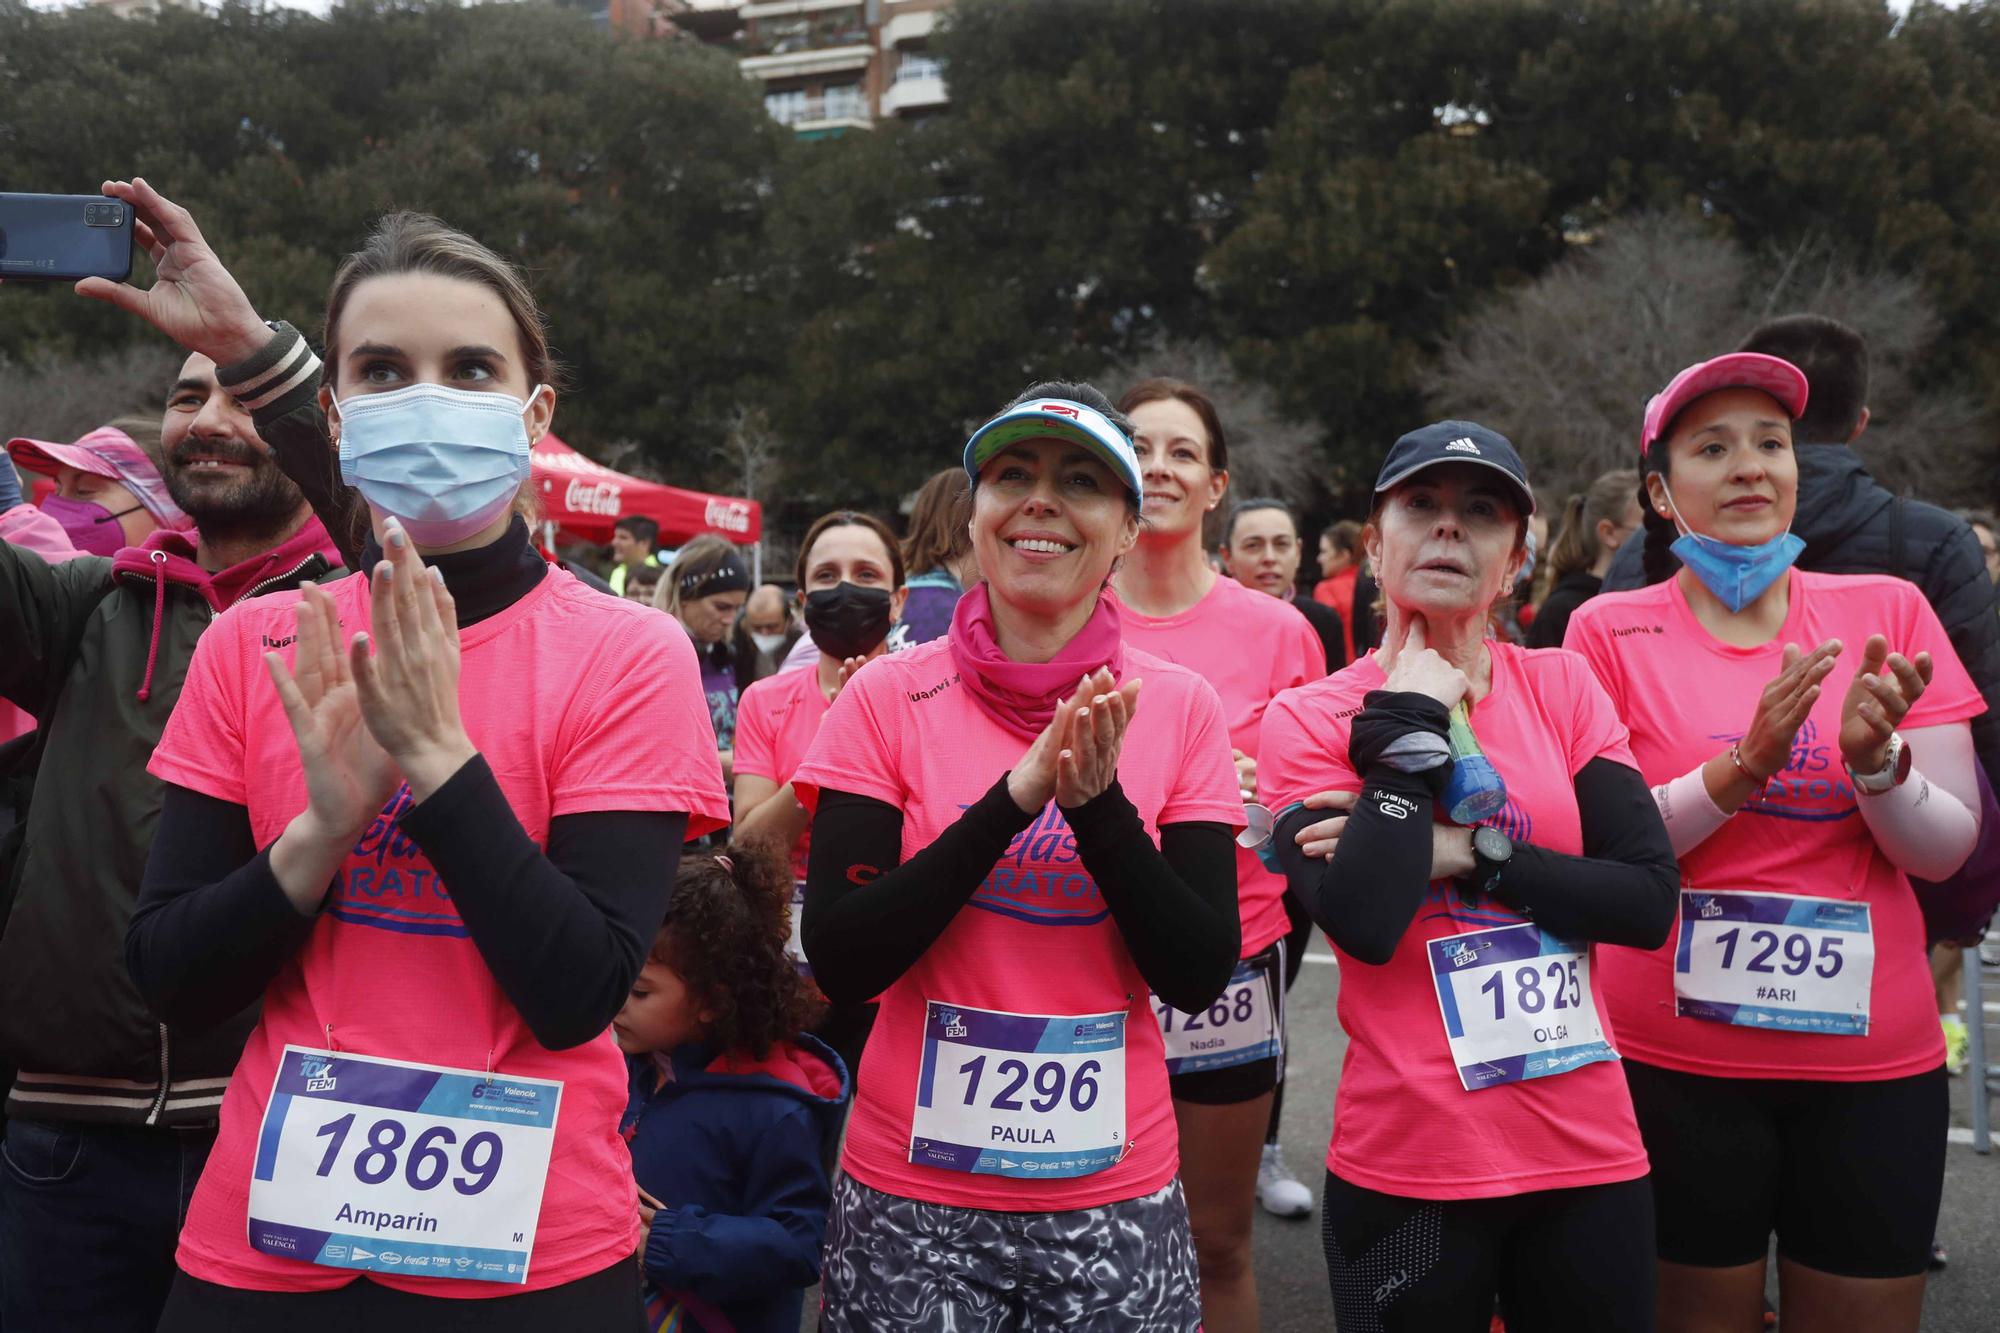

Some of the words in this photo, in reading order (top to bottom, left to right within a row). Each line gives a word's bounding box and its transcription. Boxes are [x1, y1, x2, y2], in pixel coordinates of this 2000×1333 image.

[1445, 444, 1481, 455] adidas
[565, 478, 622, 516] Coca-Cola
[1456, 952, 1476, 966] FEM
[1715, 928, 1844, 979] 1295
[1481, 960, 1581, 1021] 1825
[1756, 986, 1796, 1003] #ARI
[947, 1027, 966, 1036] FEM
[1074, 1024, 1084, 1037] 6
[1534, 1024, 1569, 1042] OLGA
[1190, 1038, 1225, 1051] Nadia
[300, 1061, 333, 1079] 10K
[308, 1079, 335, 1090] FEM
[471, 1083, 486, 1099] 6
[504, 1086, 537, 1098] Valencia
[959, 1055, 1102, 1113] 1296
[991, 1125, 1056, 1144] PAULA
[1112, 1131, 1119, 1140] S
[316, 1112, 504, 1196] 1869
[335, 1203, 438, 1233] Amparin
[512, 1232, 524, 1243] M
[1372, 1270, 1407, 1303] 2XU
